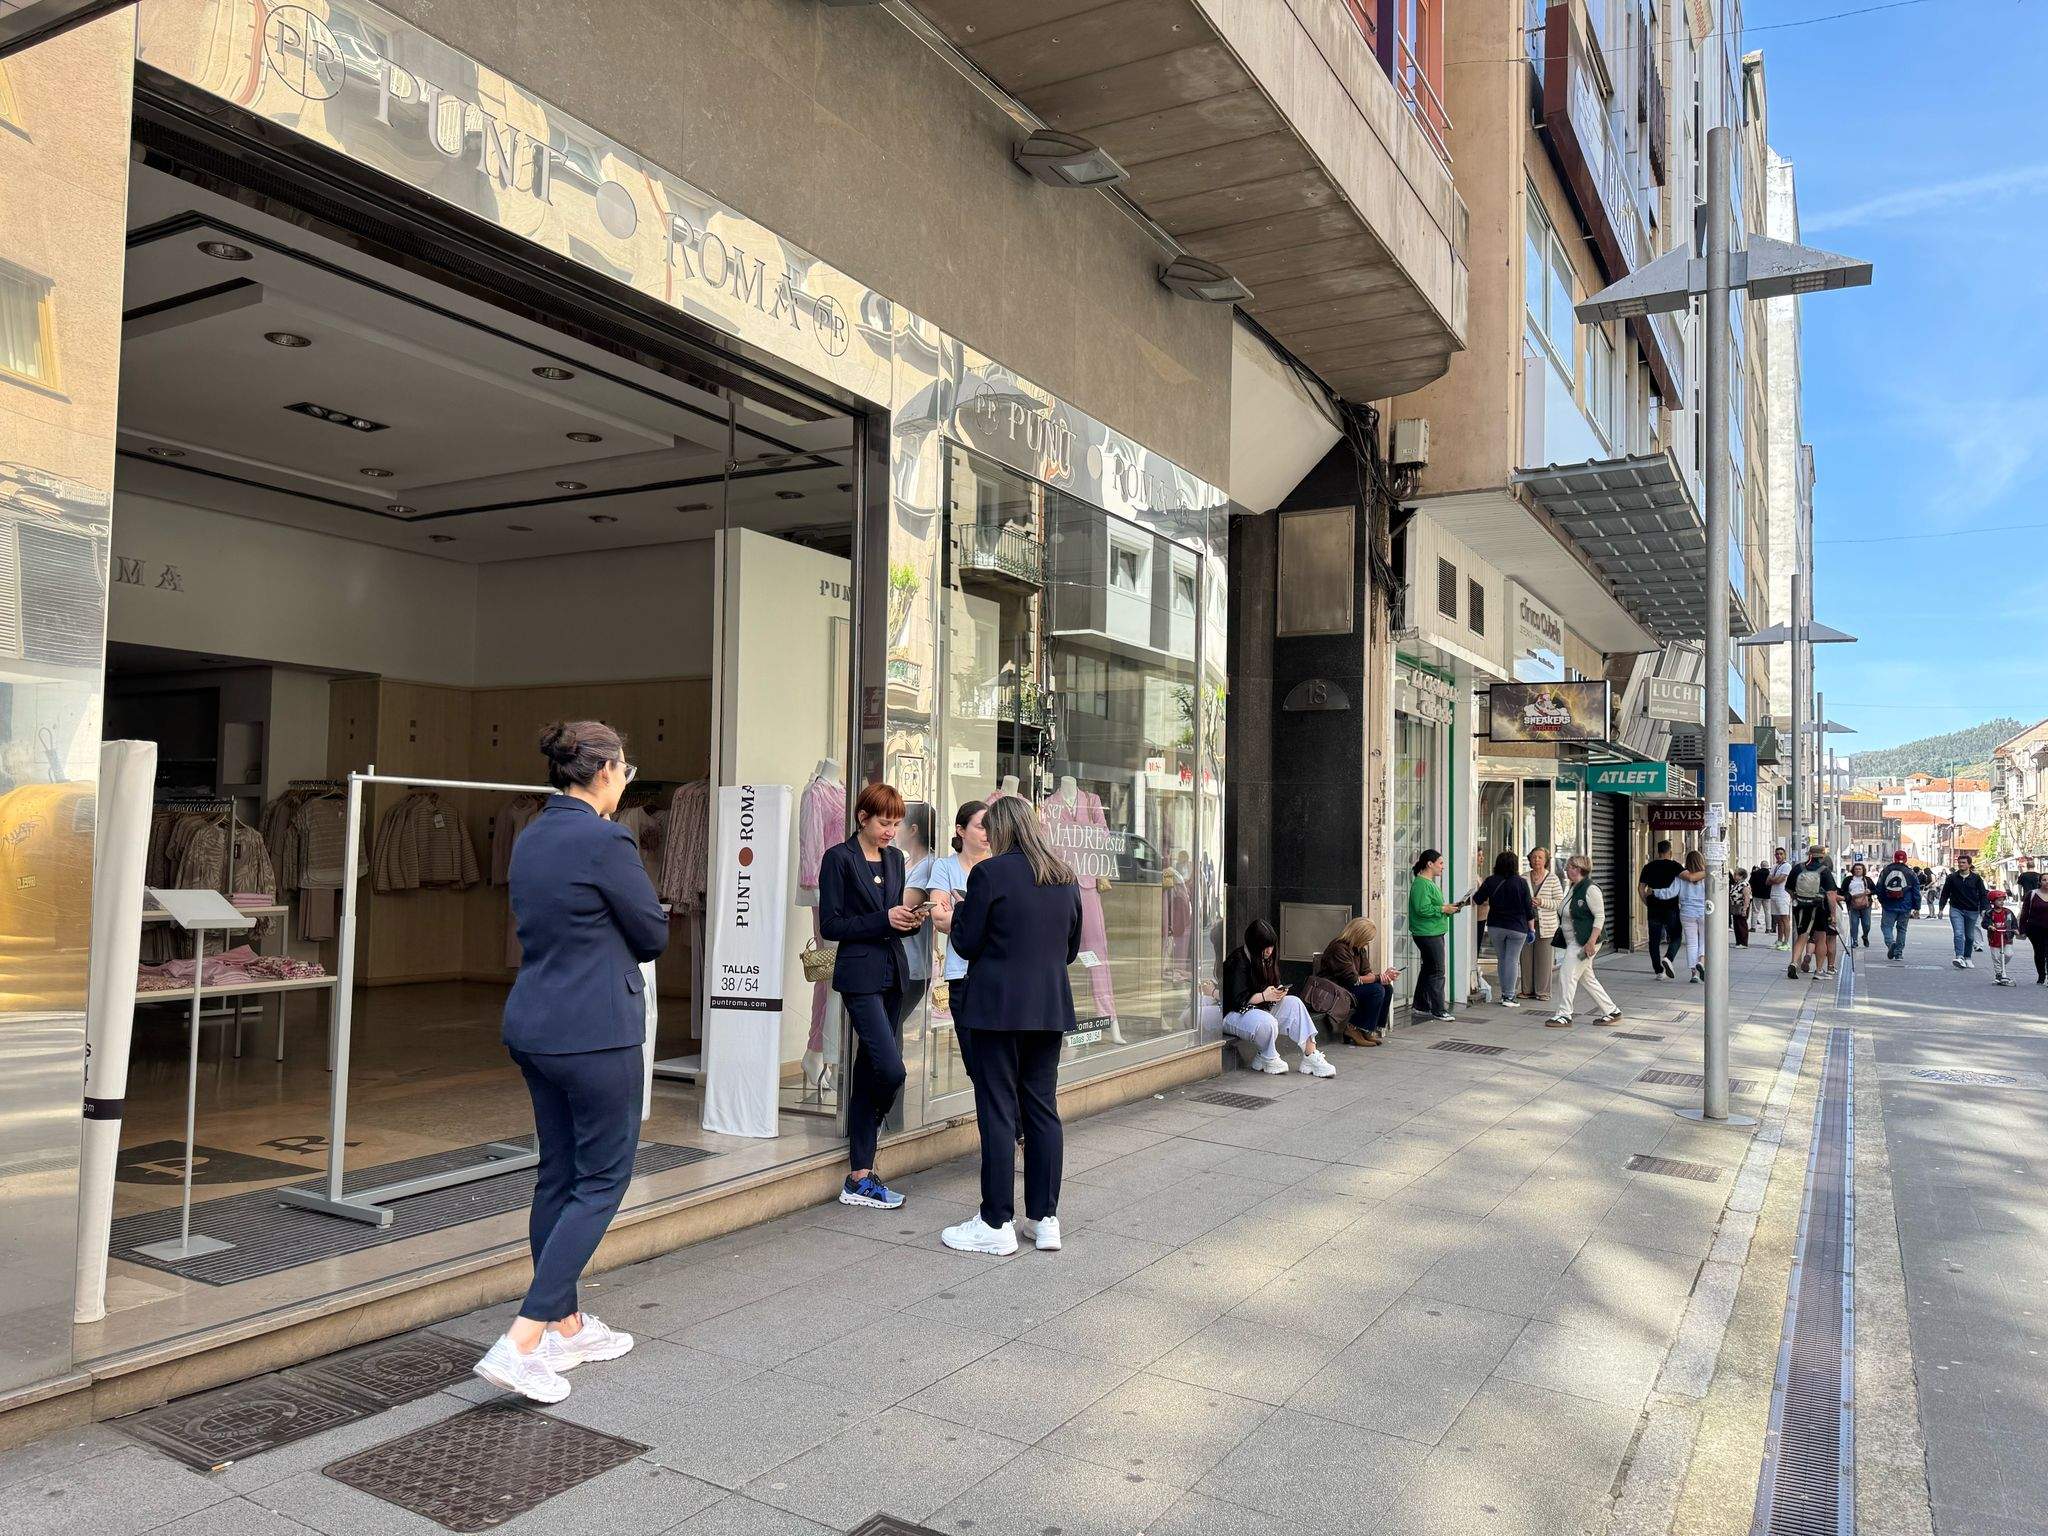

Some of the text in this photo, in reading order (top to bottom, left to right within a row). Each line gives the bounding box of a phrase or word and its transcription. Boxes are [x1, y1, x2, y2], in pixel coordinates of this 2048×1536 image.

[375, 53, 568, 206] PUNT
[663, 212, 801, 331] ROMA
[1009, 401, 1078, 472] PUNT
[1307, 683, 1327, 703] 18
[1652, 682, 1699, 701] LUCHI
[1524, 715, 1571, 725] SNEAKERS
[1597, 771, 1659, 784] ATLEET
[1664, 810, 1706, 820] DEVES
[1047, 822, 1104, 850] MADRE
[736, 785, 755, 928] PUNT ROMA
[1074, 852, 1120, 878] MODA
[722, 965, 760, 974] TALLAS
[711, 999, 767, 1008] puntroma.com
